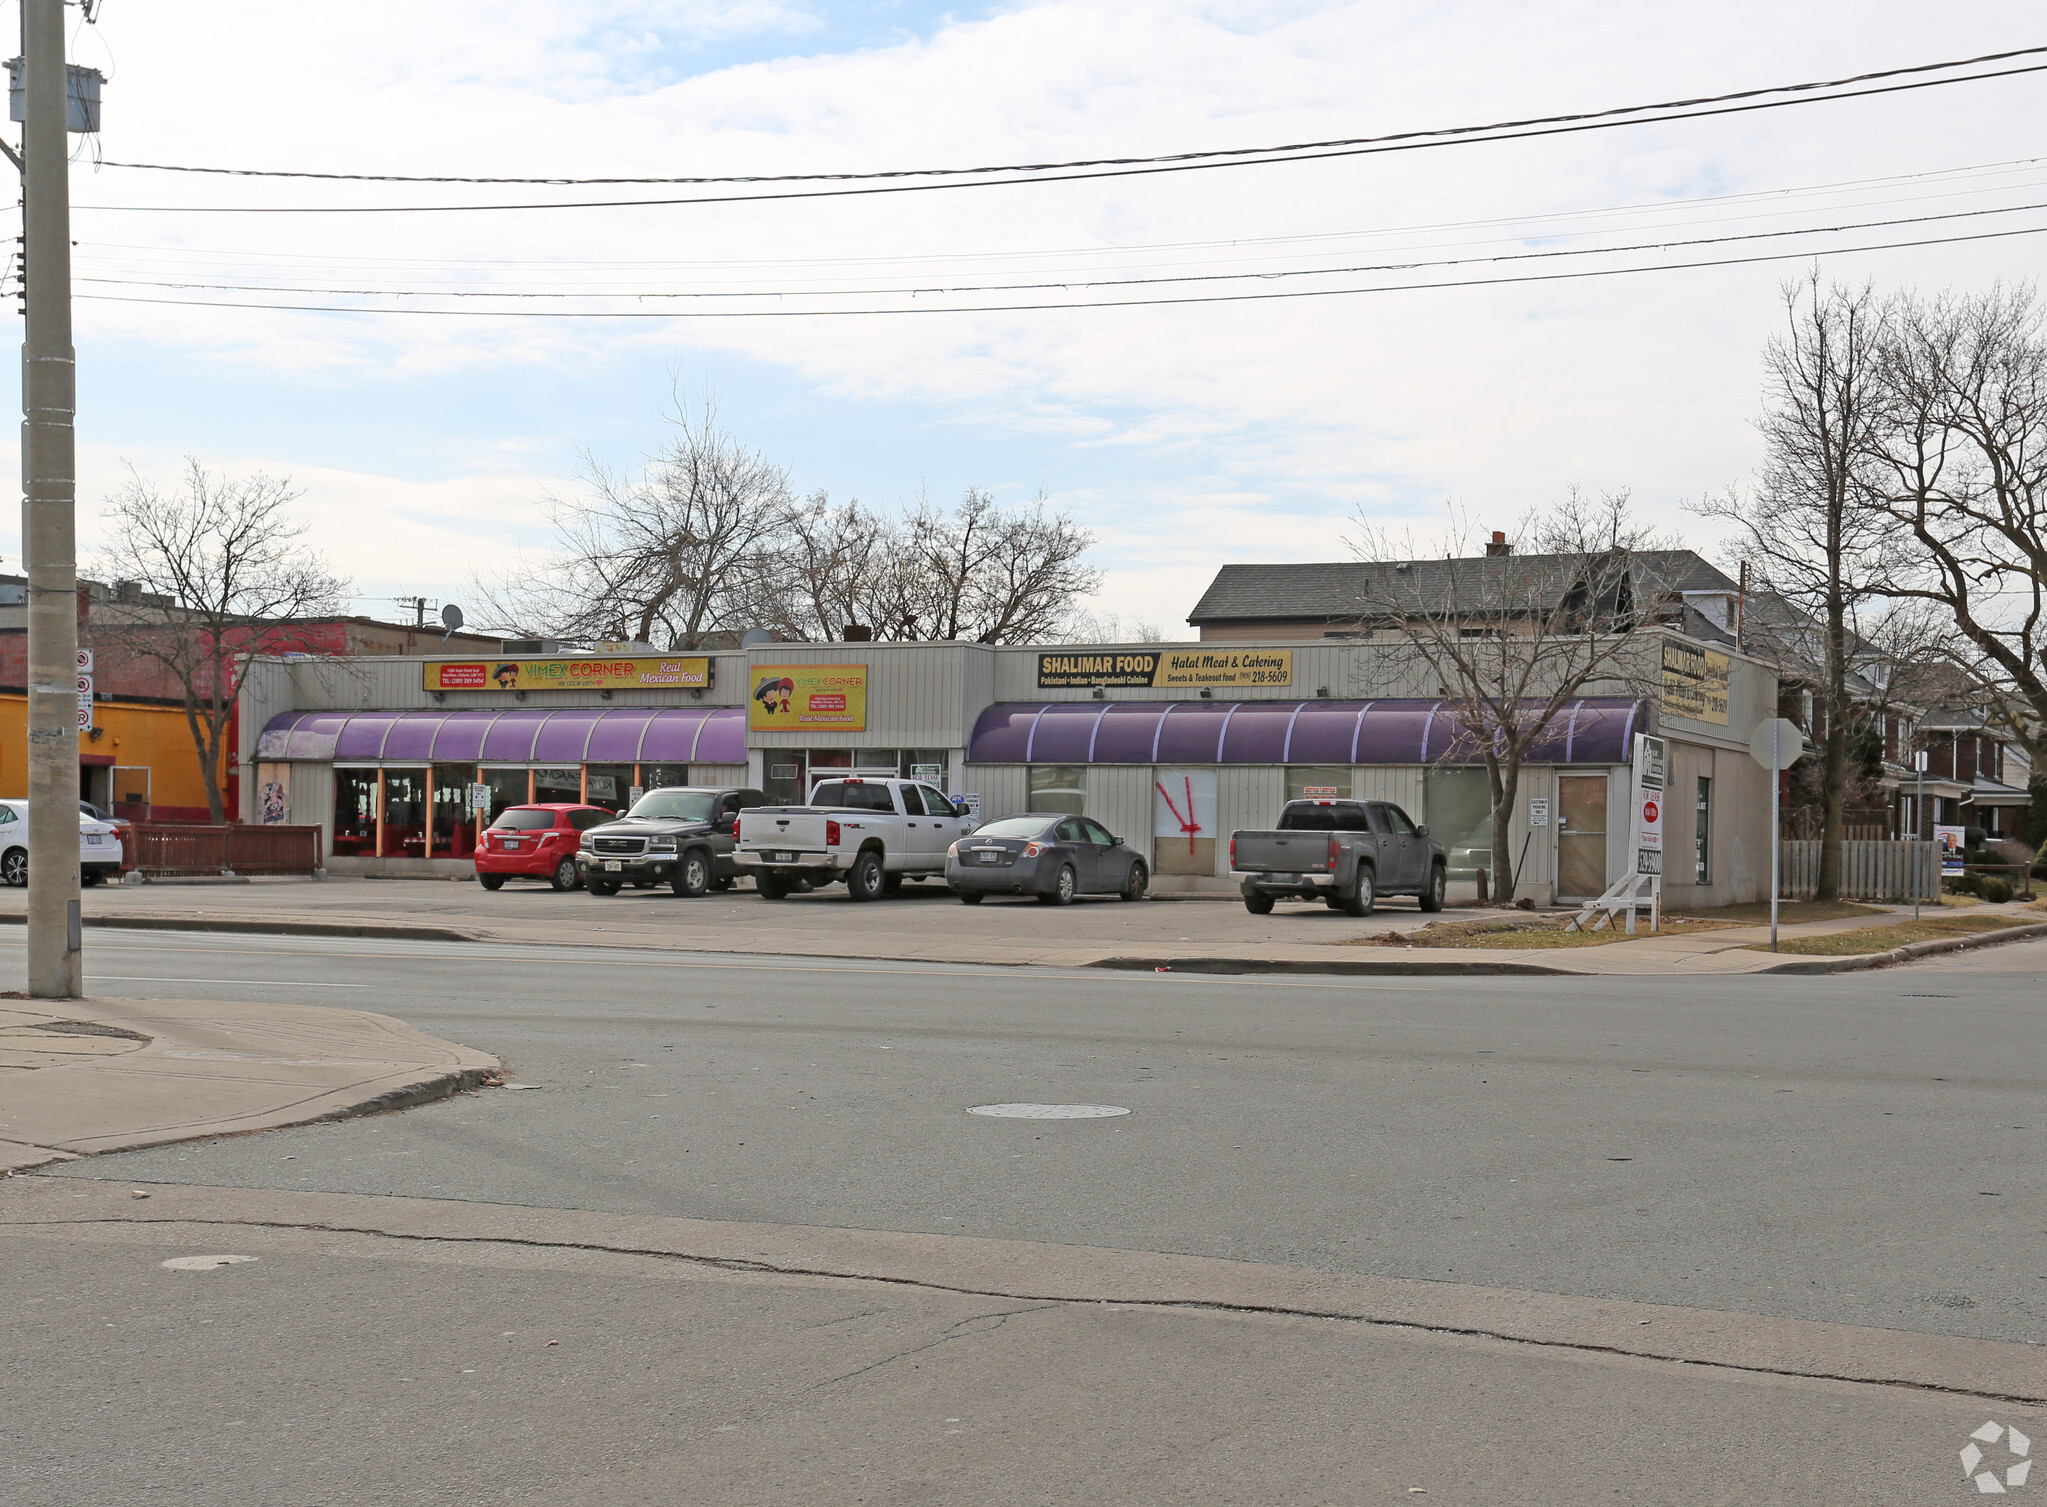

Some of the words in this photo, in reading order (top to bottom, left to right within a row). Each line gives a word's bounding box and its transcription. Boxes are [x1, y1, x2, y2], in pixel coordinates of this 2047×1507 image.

[660, 661, 681, 673] Real
[1042, 656, 1113, 673] SHALIMAR
[1116, 655, 1154, 673] FOOD
[1171, 655, 1200, 670] Halal
[1202, 655, 1229, 669] Meat
[1231, 655, 1239, 668] &
[1242, 654, 1284, 671] Catering
[524, 663, 567, 678] VIMEX
[569, 662, 635, 677] CORNER
[640, 672, 680, 683] Mexican
[680, 671, 704, 683] Food
[795, 677, 822, 686] VIMEX
[822, 677, 863, 686] CORNER
[1041, 676, 1067, 685] Pakistani
[1069, 675, 1088, 685] Indian
[1091, 675, 1126, 686] Bangladeshi
[1126, 675, 1149, 684] Cuisine
[1167, 673, 1188, 682] Sweets
[1188, 674, 1193, 682] &
[1222, 672, 1237, 682] food
[1251, 670, 1288, 683] 218-5609
[799, 714, 813, 722] Real
[813, 714, 839, 722] Mexican
[839, 714, 854, 722] Food
[1642, 789, 1650, 800] FOR
[1650, 790, 1661, 802] LEASE
